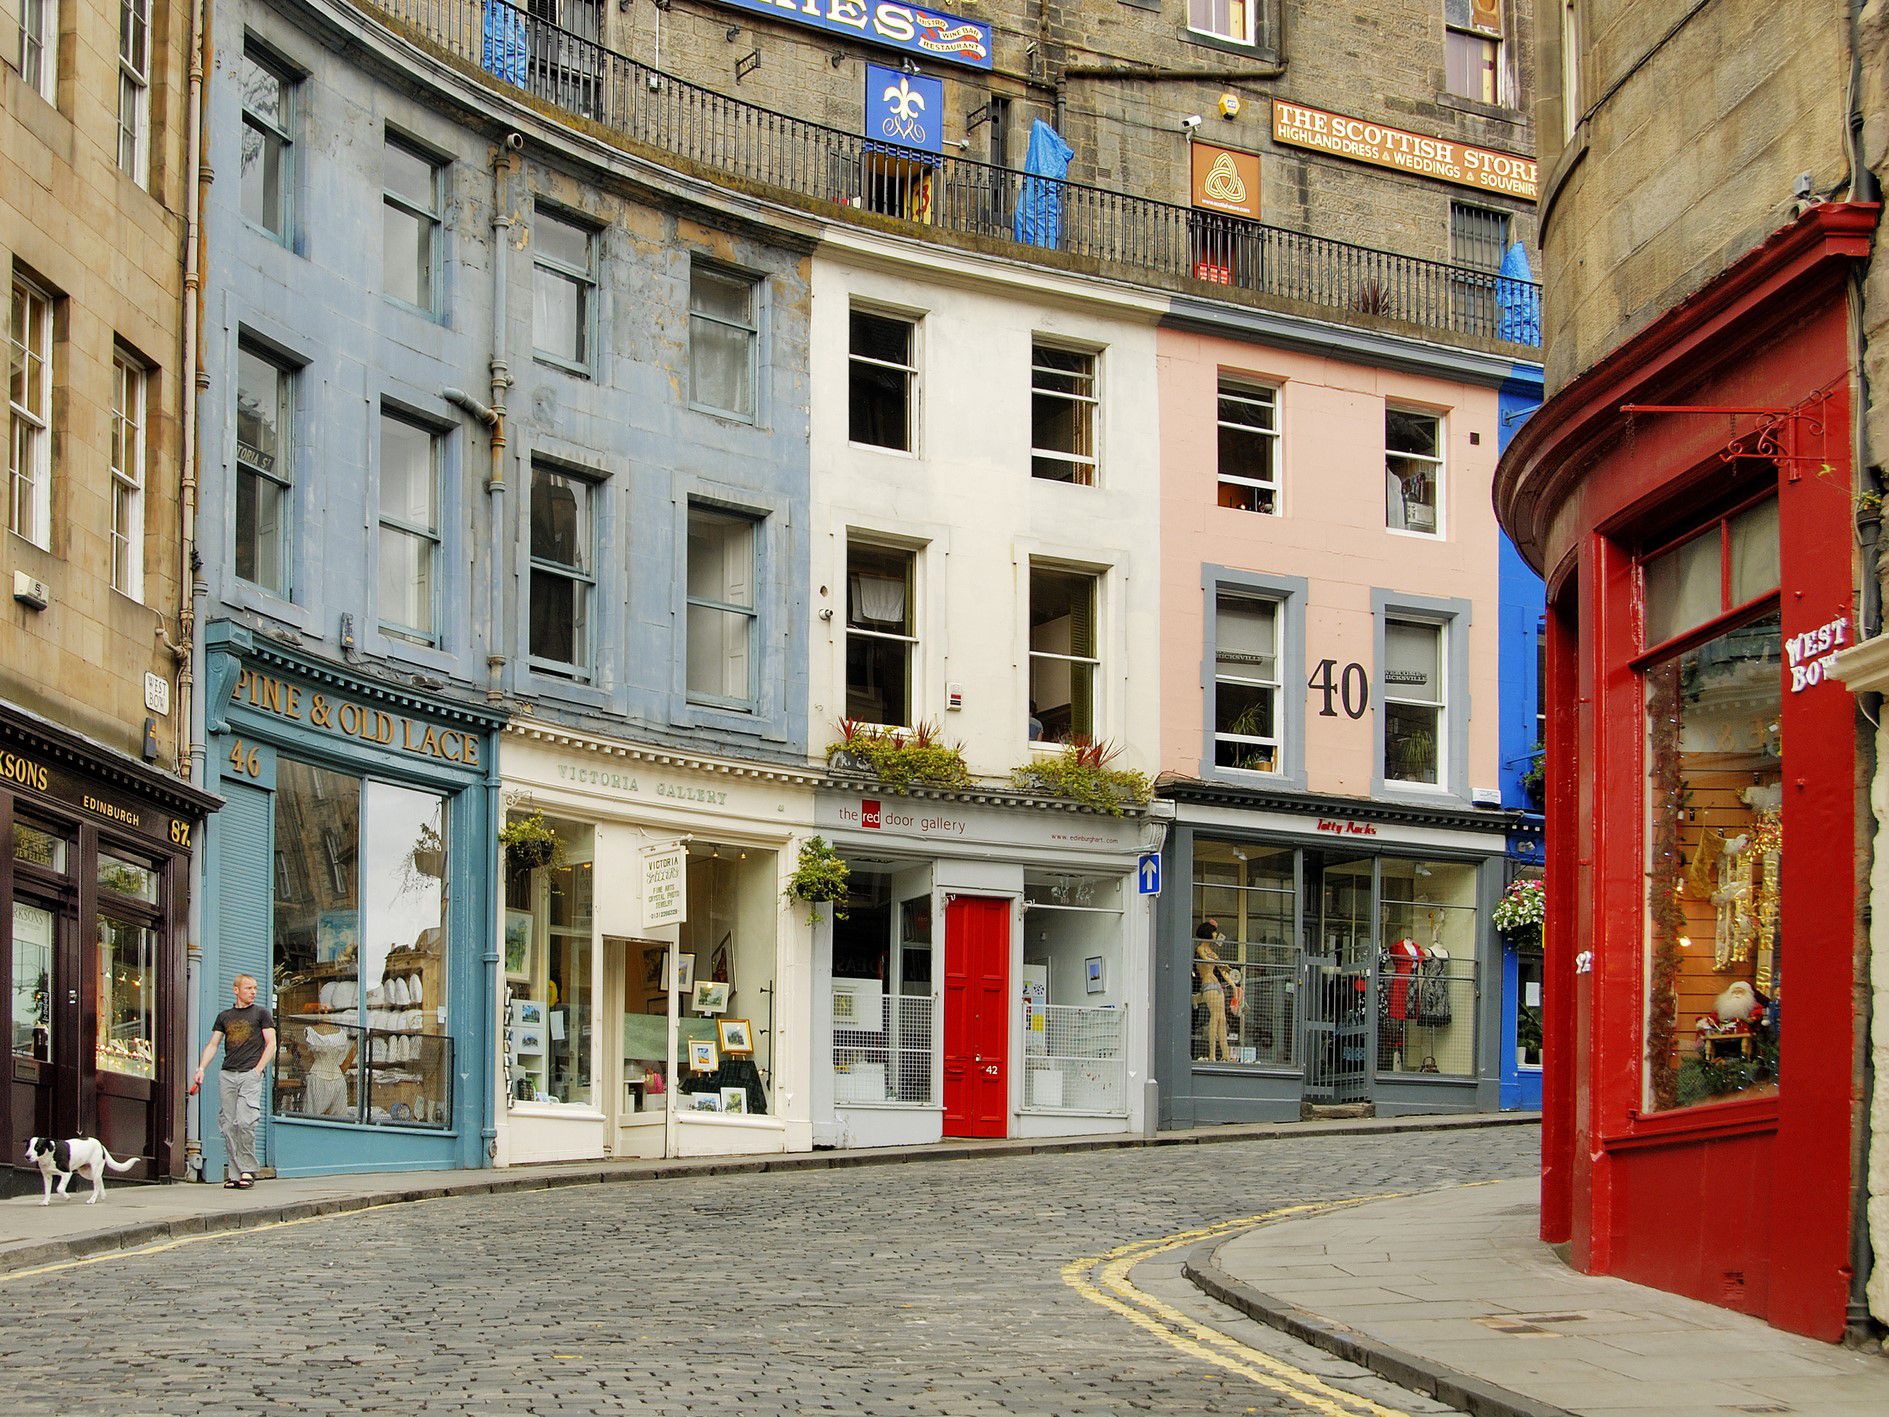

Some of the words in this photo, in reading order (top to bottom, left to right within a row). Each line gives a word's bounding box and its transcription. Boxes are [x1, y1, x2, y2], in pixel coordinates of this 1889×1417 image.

[923, 41, 979, 51] RESTAURANT
[943, 30, 961, 39] WINE
[962, 26, 979, 36] BAR
[1277, 104, 1328, 134] THE
[1331, 117, 1454, 164] SCOTTISH
[1393, 151, 1461, 179] WEDDINGS
[1480, 172, 1537, 197] SOUVENIR
[1785, 617, 1849, 667] WEST
[147, 676, 166, 696] WEST
[149, 692, 165, 709] BOW
[1307, 658, 1369, 720] 40
[232, 669, 302, 720] PINE
[311, 693, 334, 728] &
[339, 702, 395, 745] OLD
[402, 719, 480, 766] LACE
[230, 739, 262, 777] 46
[557, 764, 639, 792] VICTORIA
[656, 782, 728, 806] GALLERY
[83, 795, 139, 827] EDINBURGH
[839, 807, 858, 821] the
[862, 810, 880, 824] red
[885, 811, 914, 827] door
[920, 815, 966, 834] gallery
[649, 856, 679, 871] VICTORIA
[986, 1065, 998, 1075] 42
